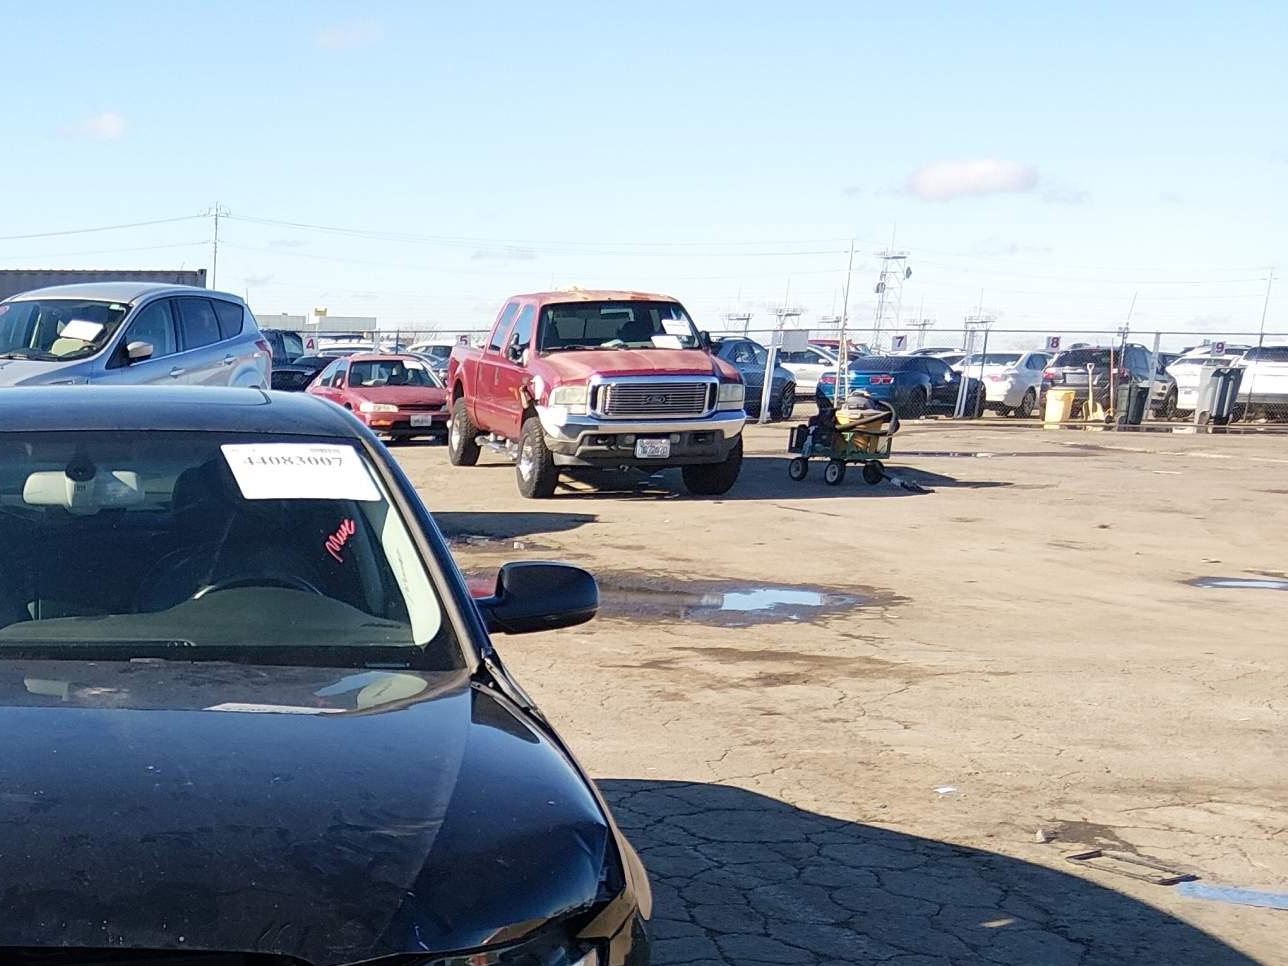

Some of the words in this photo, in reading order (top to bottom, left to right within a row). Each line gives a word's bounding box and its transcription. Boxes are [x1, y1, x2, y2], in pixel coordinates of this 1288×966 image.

[306, 338, 315, 350] 4
[460, 335, 468, 345] 5
[896, 336, 904, 347] 7
[1051, 336, 1059, 348] 8
[1215, 342, 1224, 353] 9
[243, 456, 343, 467] 44083007
